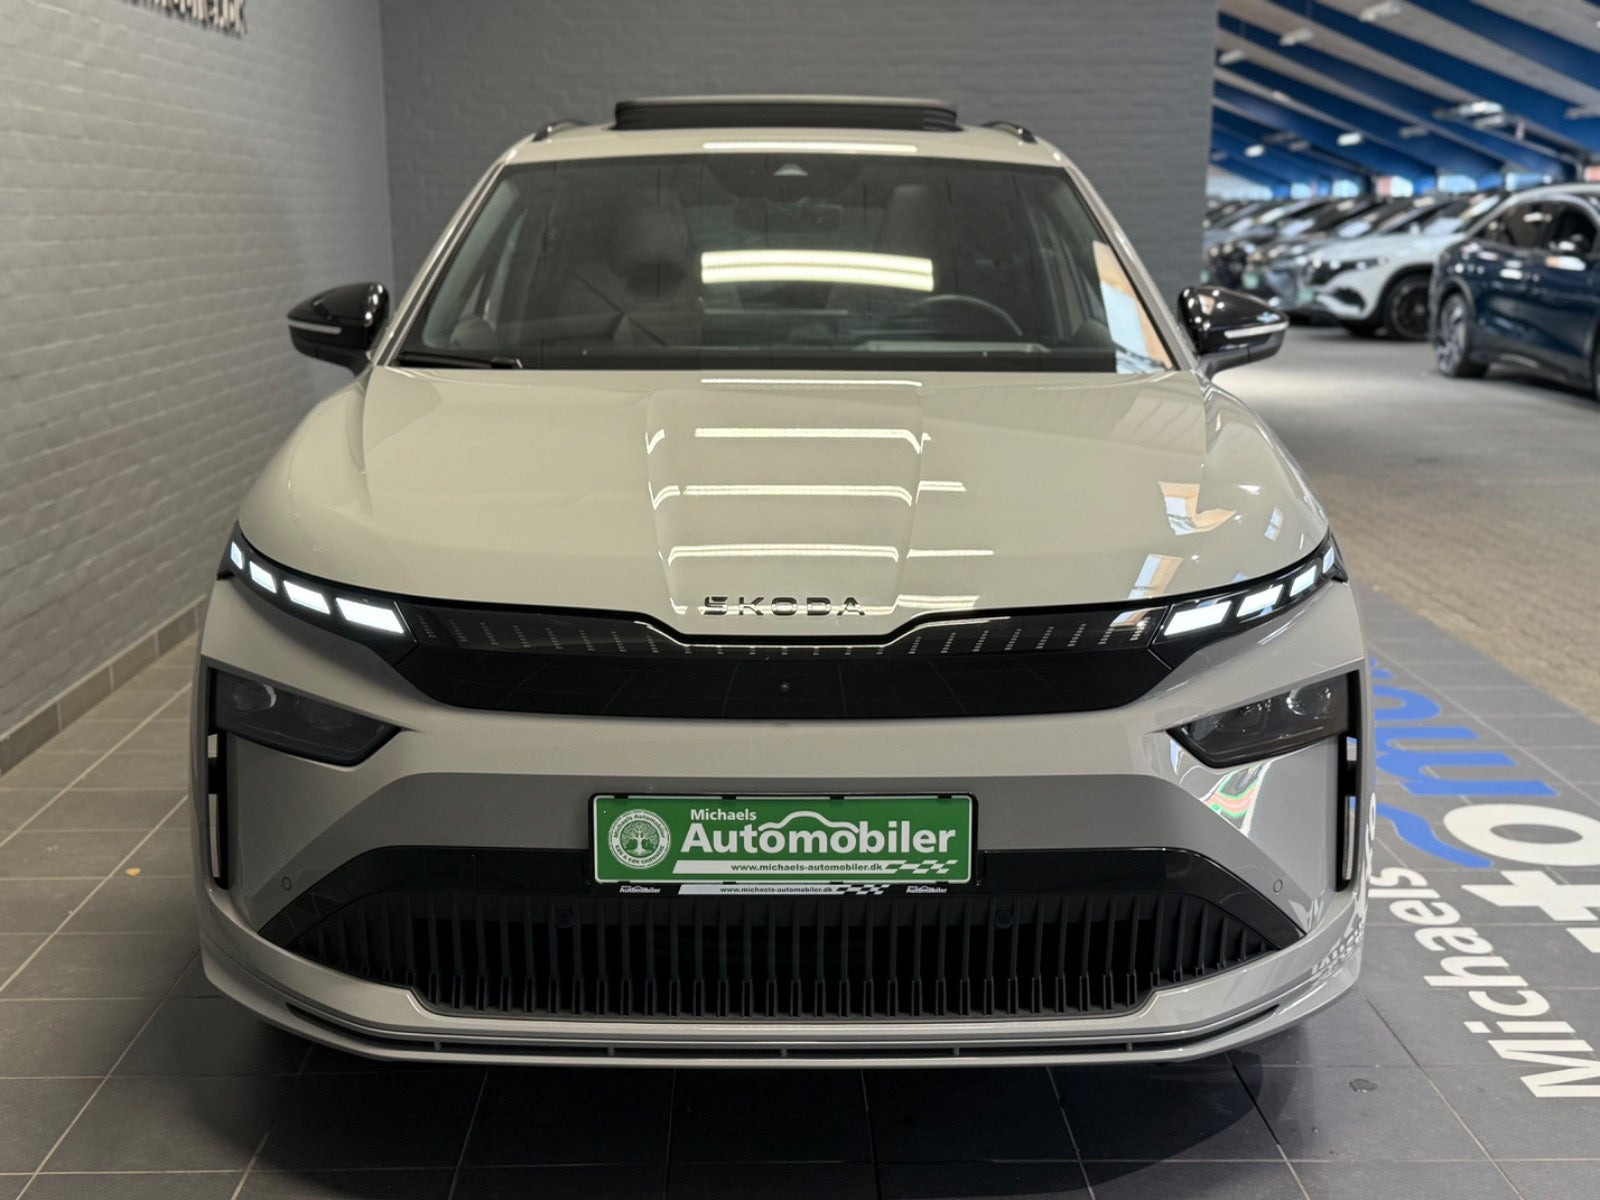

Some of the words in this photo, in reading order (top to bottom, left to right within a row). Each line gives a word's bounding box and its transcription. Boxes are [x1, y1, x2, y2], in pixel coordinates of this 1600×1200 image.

[690, 808, 757, 821] Michaels
[680, 820, 956, 854] Automobiler
[730, 863, 883, 872] www.michaels-automobiler.dk
[1368, 866, 1600, 1098] Michaels
